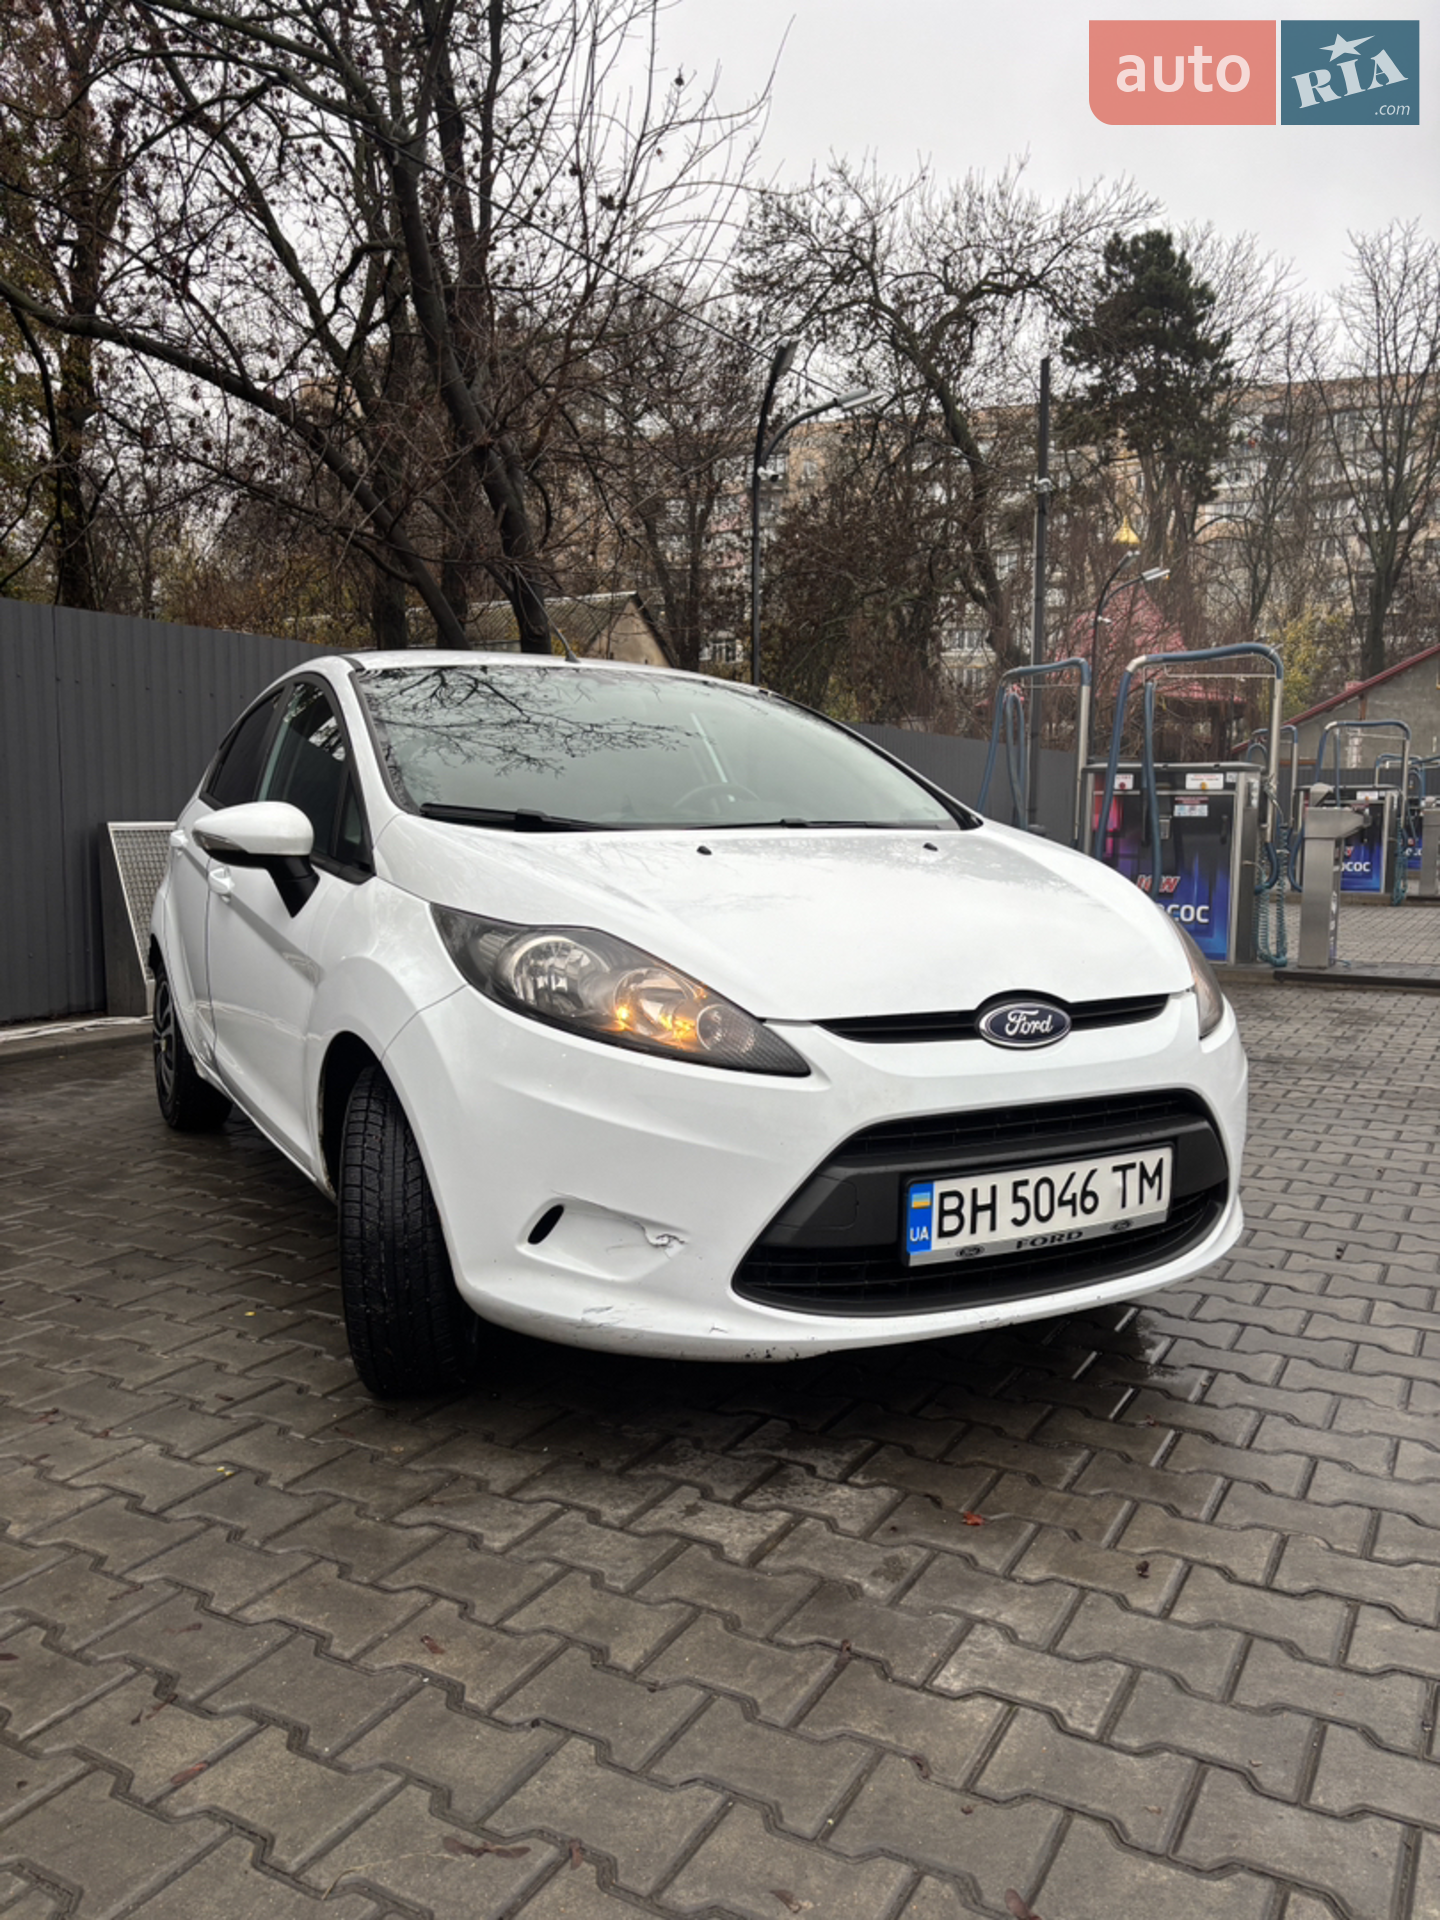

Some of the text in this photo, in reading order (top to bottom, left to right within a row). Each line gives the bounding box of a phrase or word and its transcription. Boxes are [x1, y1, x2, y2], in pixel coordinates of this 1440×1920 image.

[1004, 1009, 1054, 1037] Ford
[937, 1157, 1164, 1239] BH 5046 TM
[909, 1226, 930, 1242] UA
[1015, 1230, 1083, 1250] FORD
